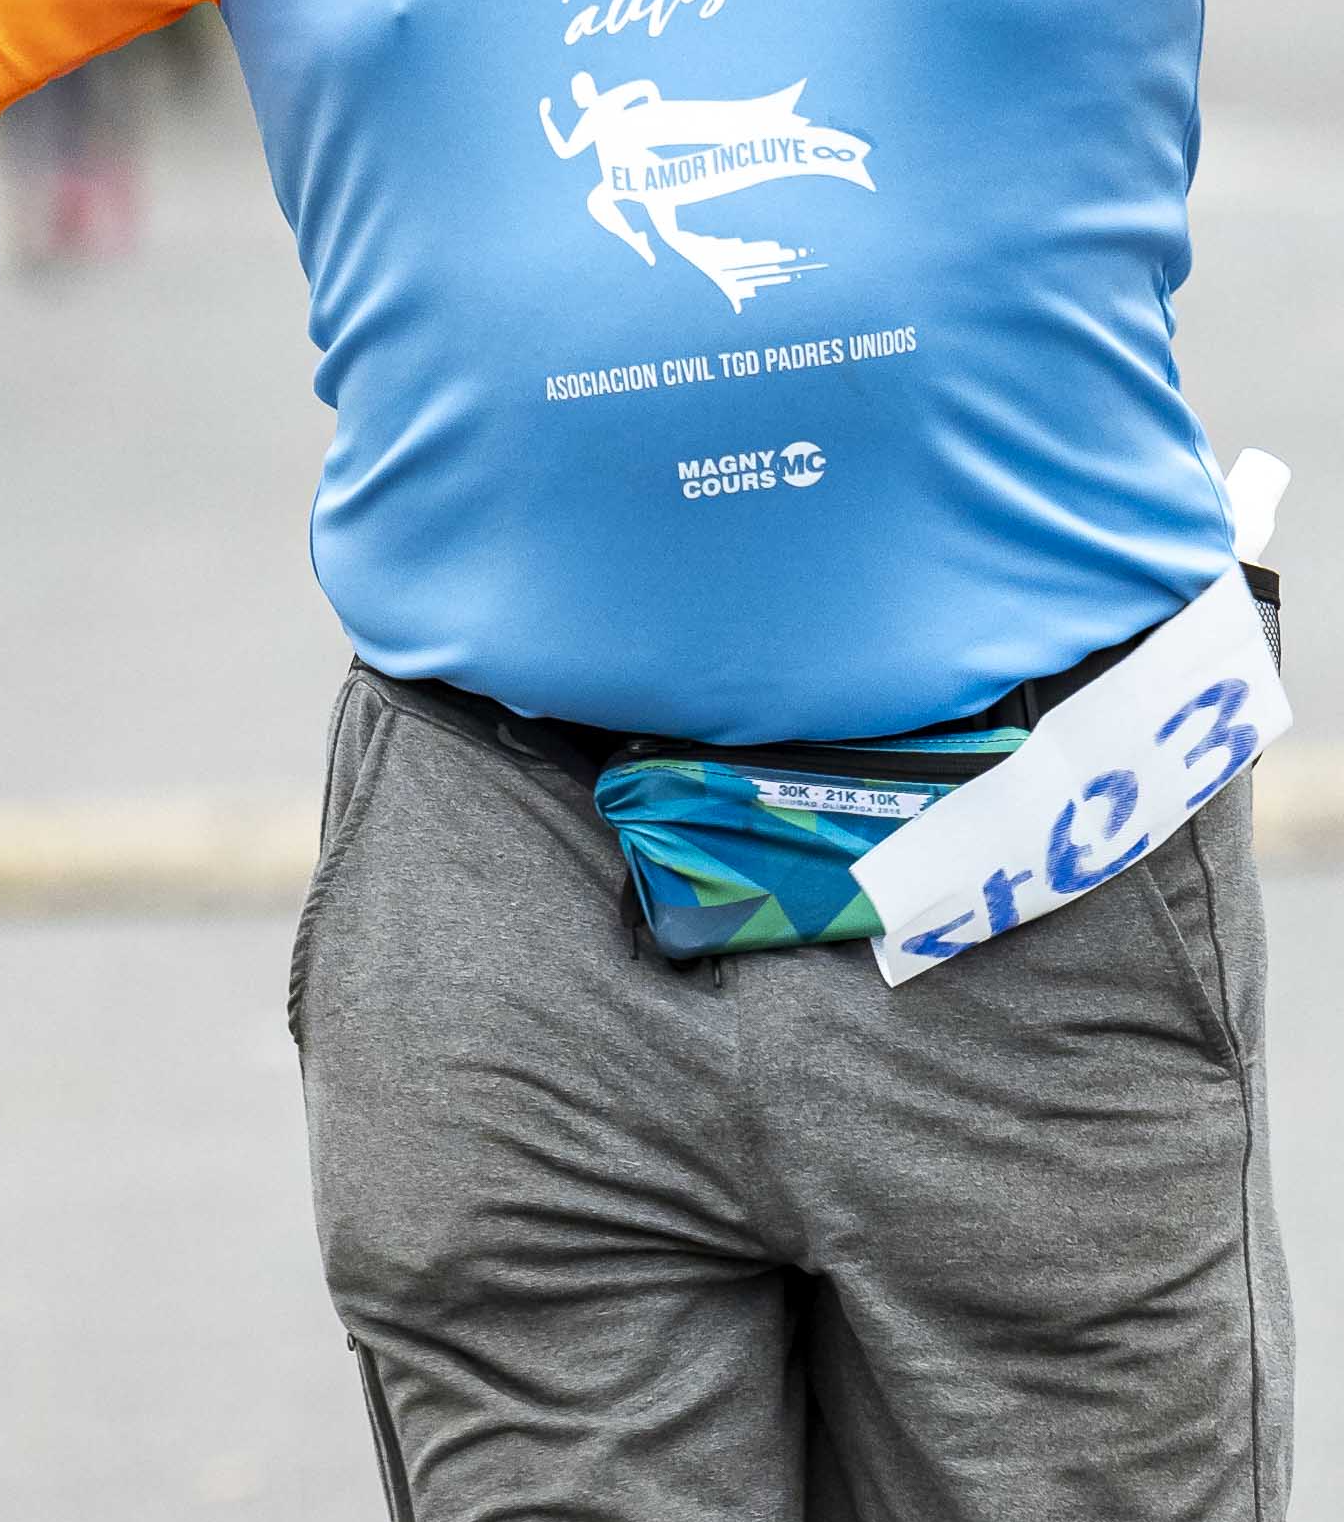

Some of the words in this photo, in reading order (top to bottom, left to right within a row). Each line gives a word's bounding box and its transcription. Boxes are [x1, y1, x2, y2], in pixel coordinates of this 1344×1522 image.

[611, 165, 638, 192] EL
[644, 154, 708, 192] AMOR
[712, 137, 808, 176] INCLUYE
[545, 362, 659, 402] ASOCIACION
[662, 352, 716, 387] CIVIL
[718, 345, 760, 380] TGD
[764, 337, 845, 373] PADRES
[849, 325, 917, 361] UNIDOS
[677, 450, 777, 480] MAGNY
[777, 448, 827, 480] MC
[682, 469, 778, 500] COURS
[778, 784, 811, 799] 30K
[826, 789, 857, 804] 21K
[869, 793, 900, 807] 10K
